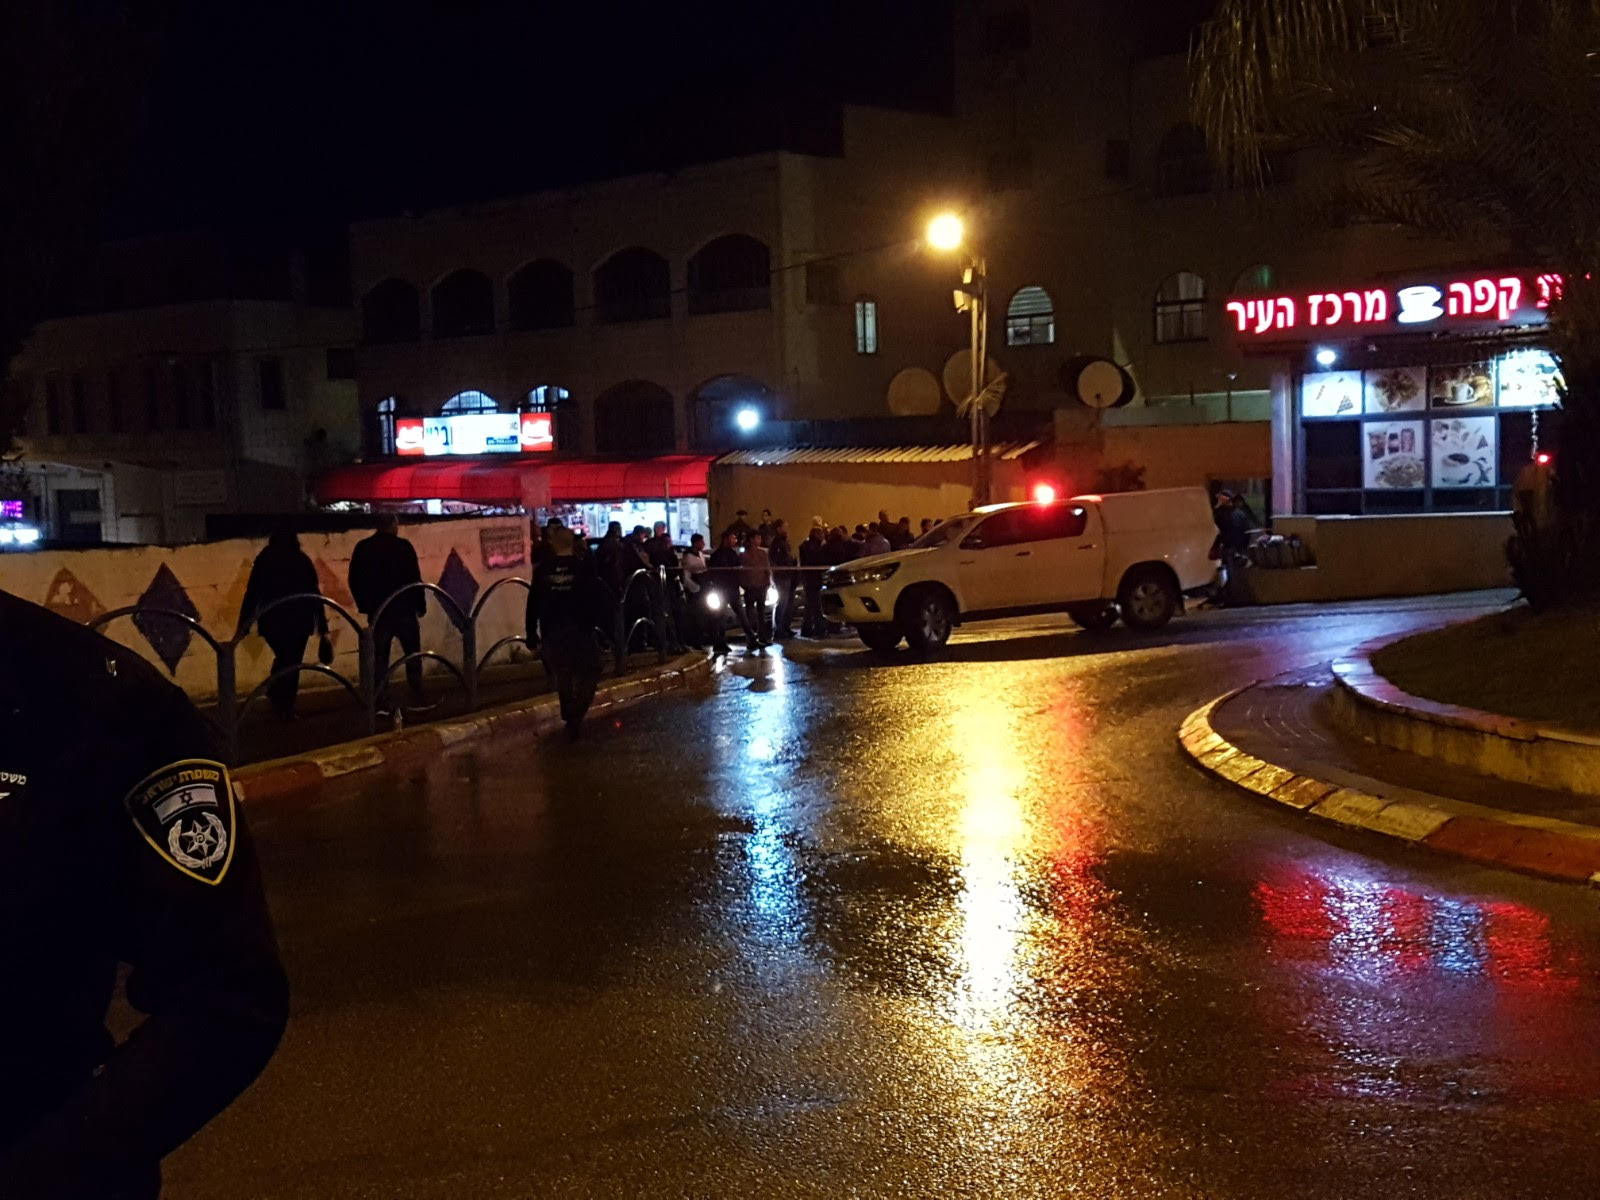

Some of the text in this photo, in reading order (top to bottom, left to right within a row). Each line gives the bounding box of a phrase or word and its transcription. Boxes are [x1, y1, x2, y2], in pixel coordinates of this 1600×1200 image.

[1226, 296, 1295, 334] העיר
[1308, 289, 1388, 325] מרכז
[1448, 278, 1521, 321] קפה
[0, 771, 28, 785] משט
